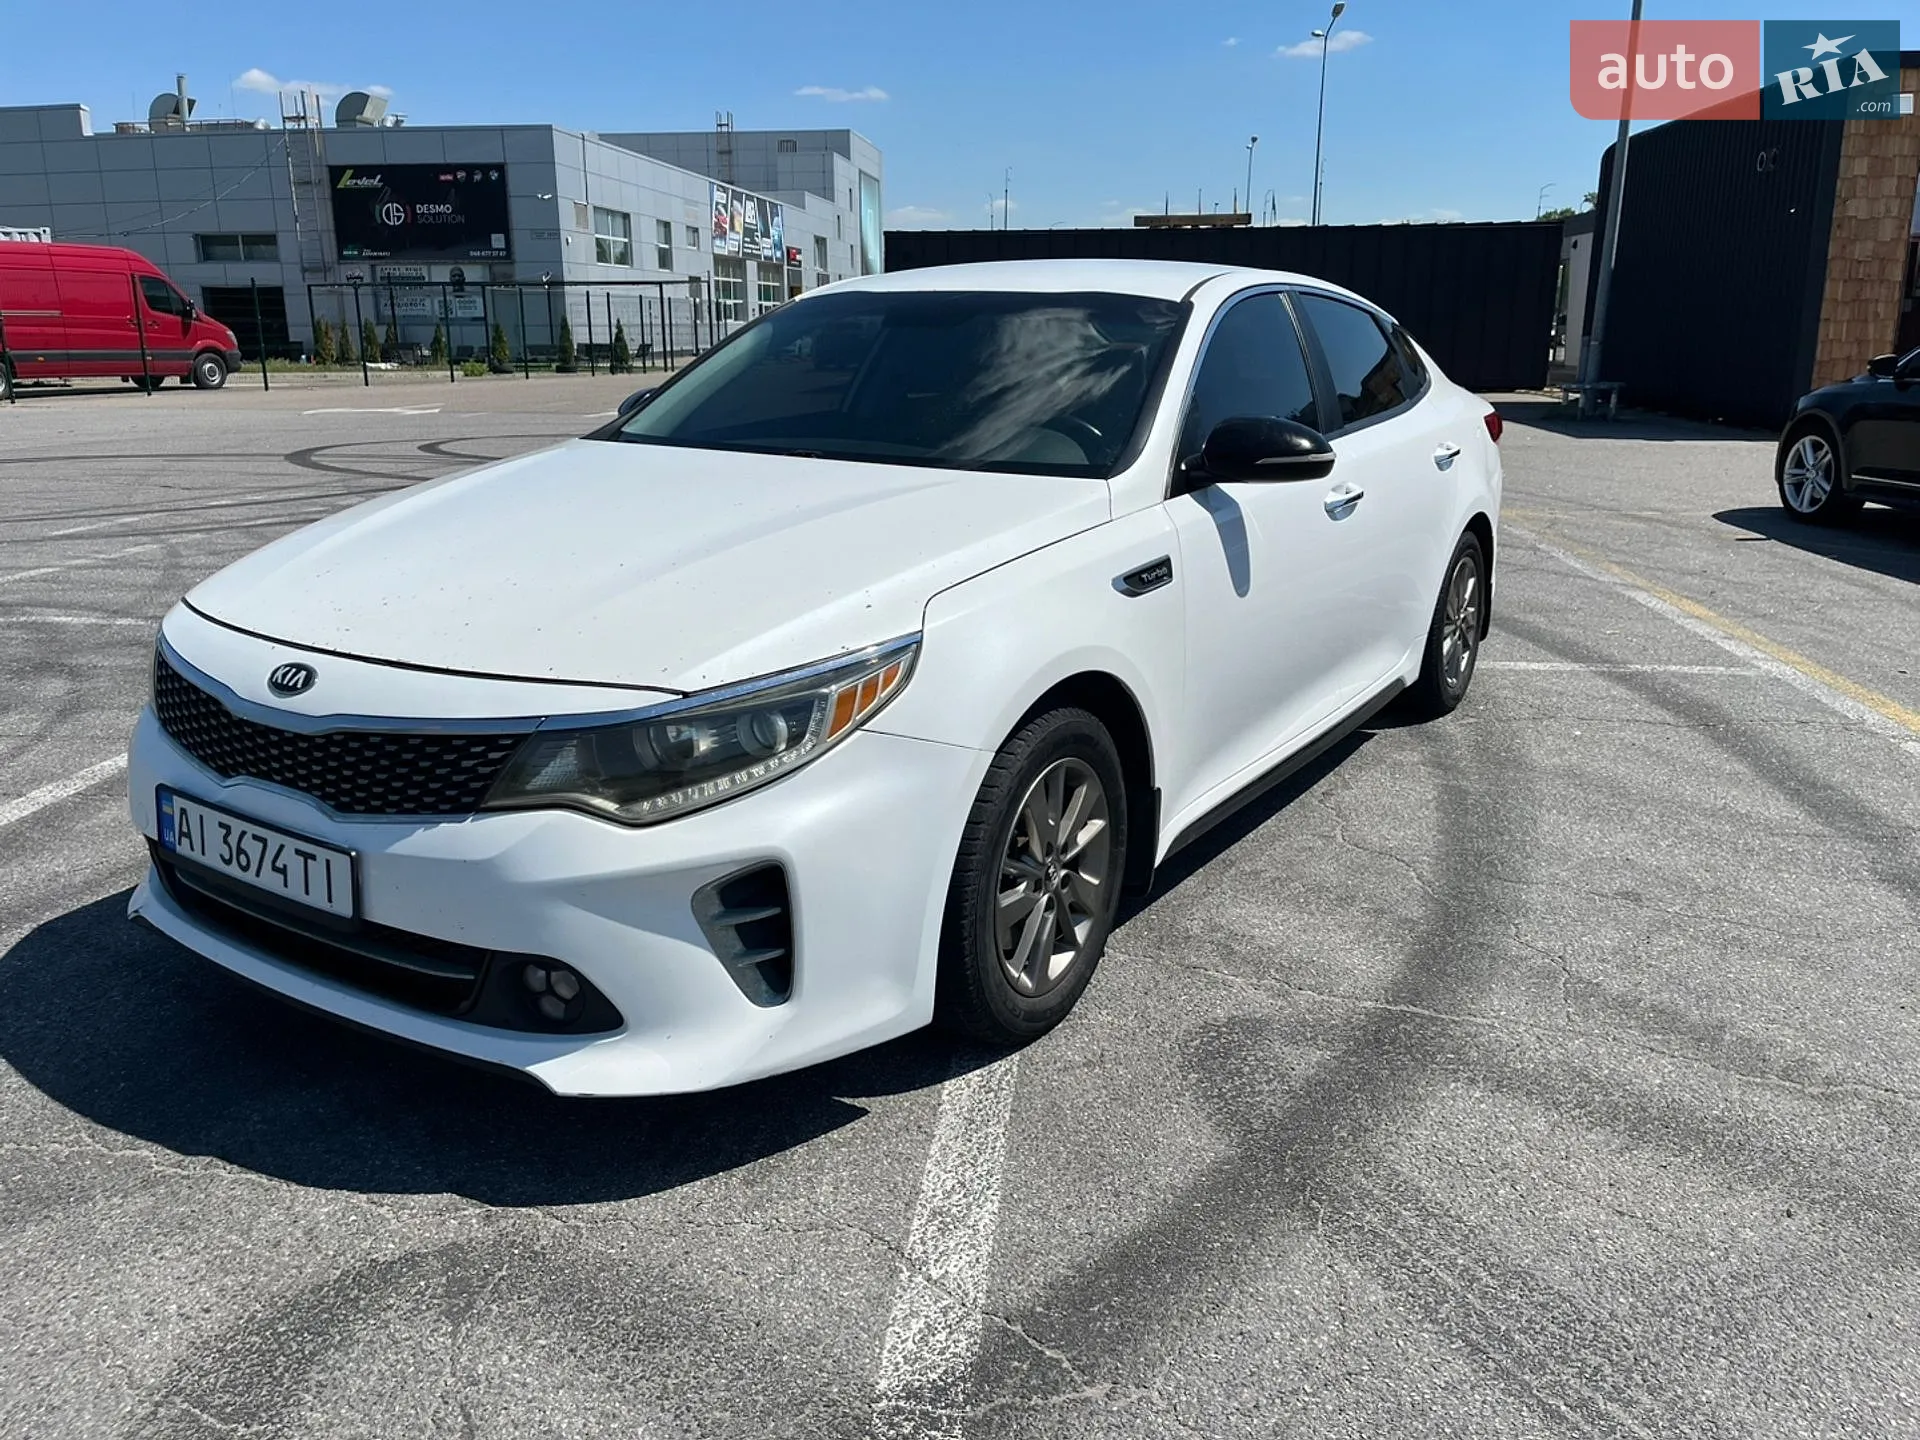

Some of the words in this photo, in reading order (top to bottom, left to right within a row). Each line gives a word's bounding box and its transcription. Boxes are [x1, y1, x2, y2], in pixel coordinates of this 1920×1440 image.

[416, 204, 452, 214] DESMO
[417, 214, 465, 225] SOLUTION
[1141, 567, 1168, 582] Turbo
[272, 665, 307, 688] KIA
[163, 829, 176, 843] UA
[177, 807, 206, 857] AI
[218, 821, 289, 889] 3674
[295, 847, 333, 904] TI
